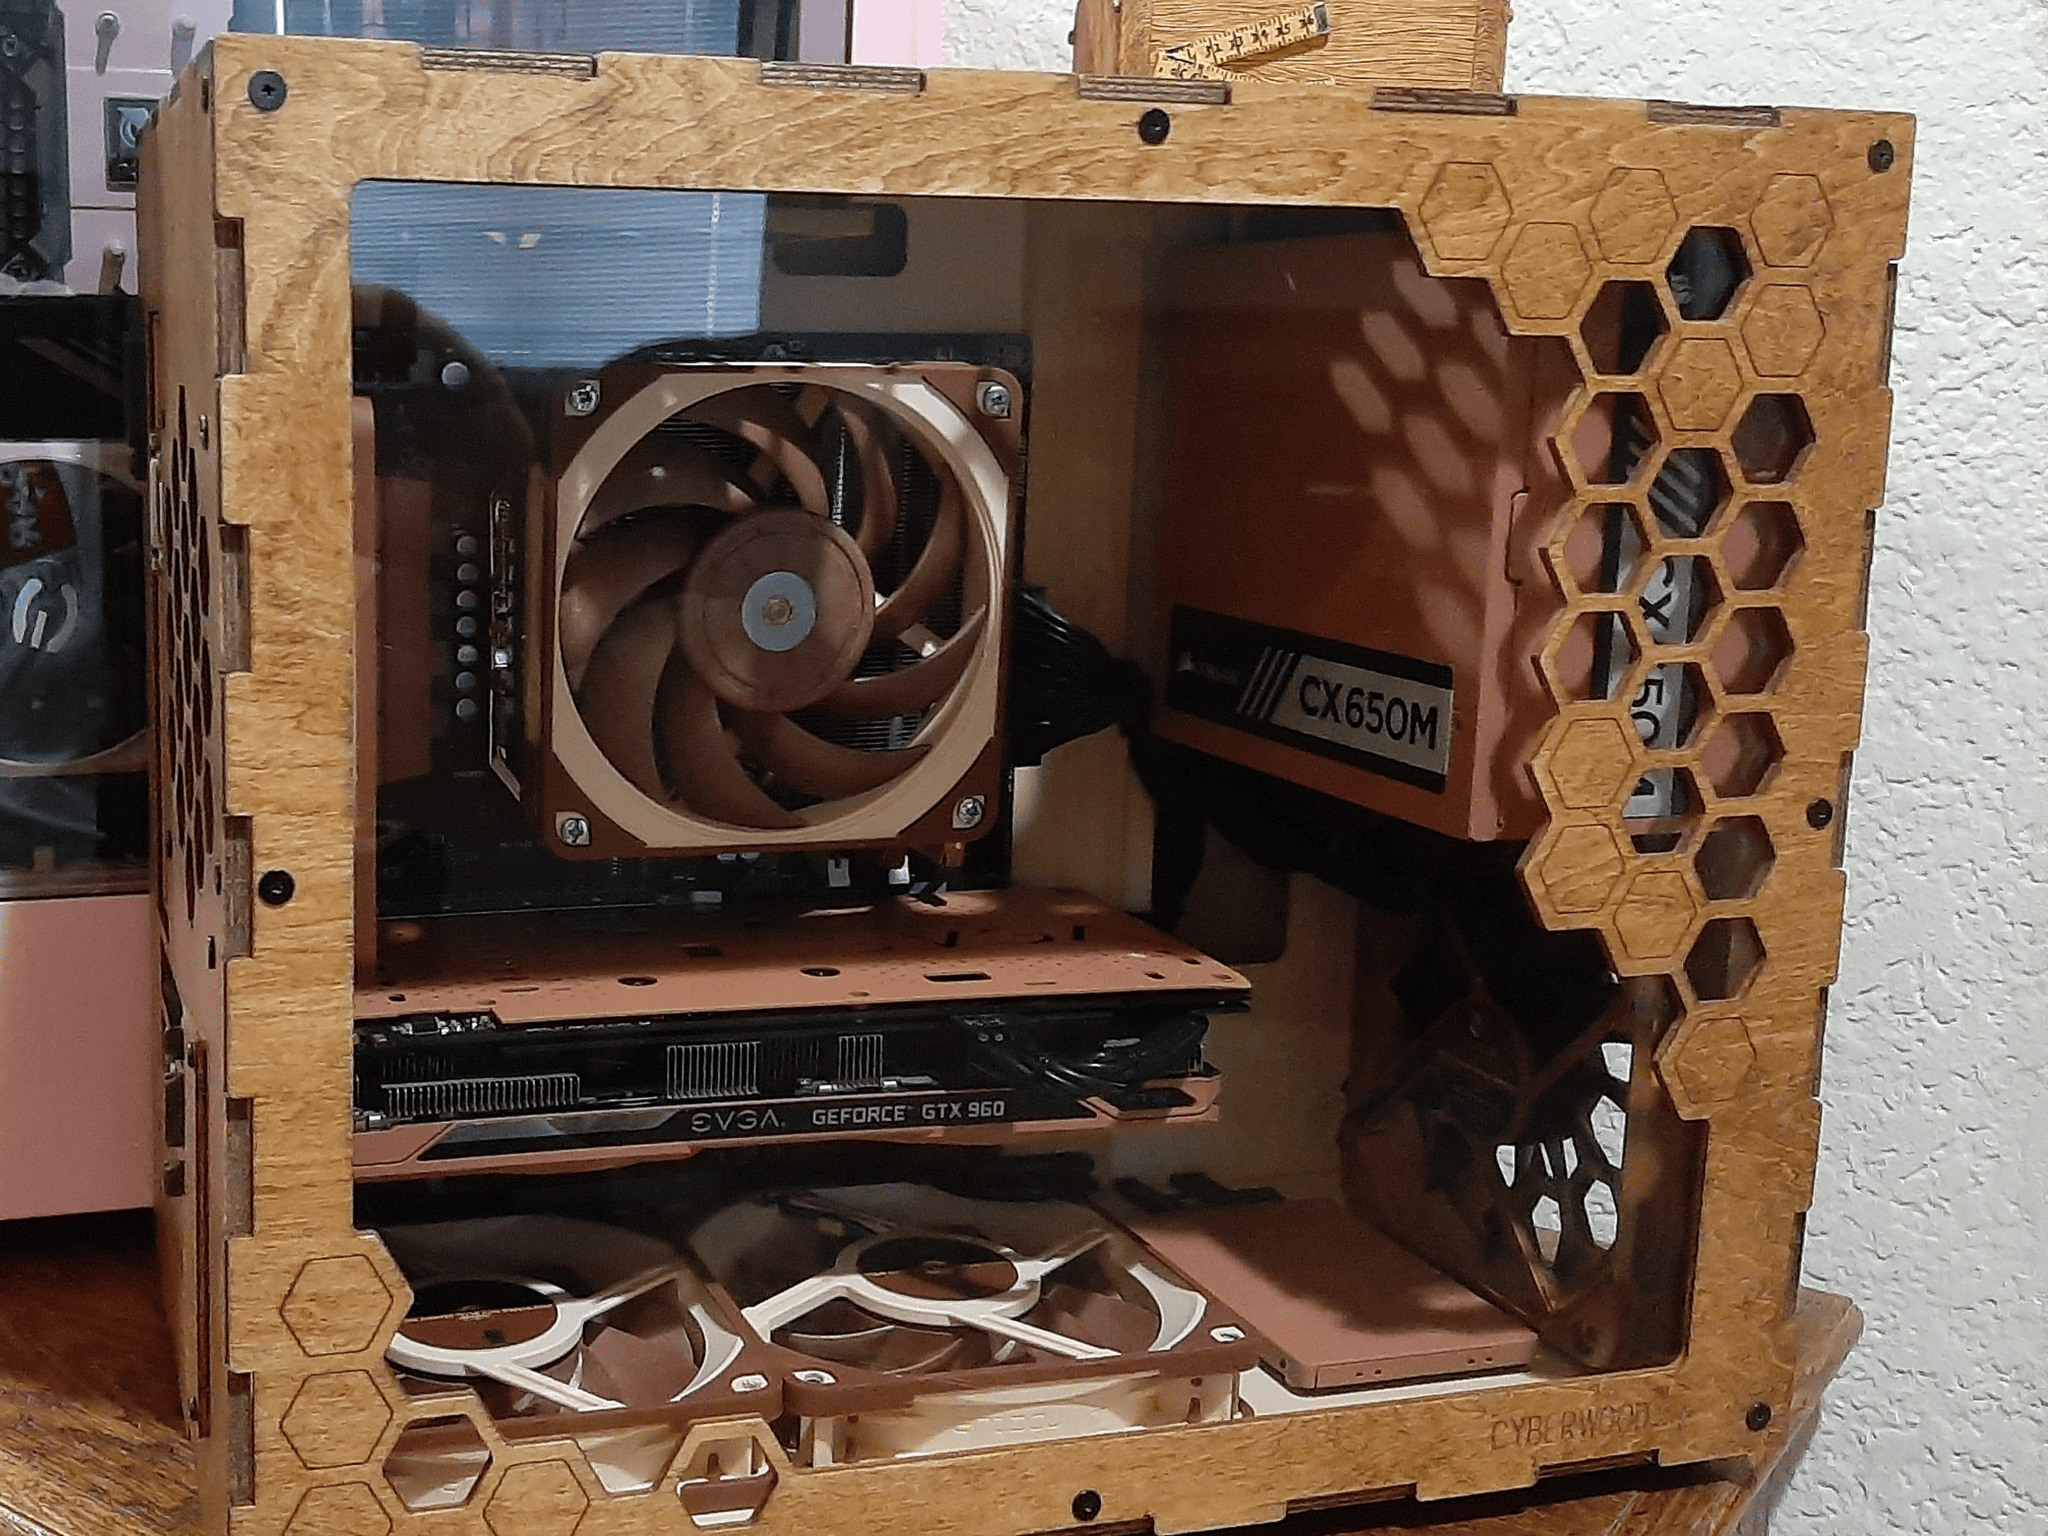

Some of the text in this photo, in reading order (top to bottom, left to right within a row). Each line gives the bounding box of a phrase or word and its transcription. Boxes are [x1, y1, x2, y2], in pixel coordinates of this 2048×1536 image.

[1299, 675, 1437, 750] CX650M
[691, 1100, 1005, 1133] EVGA GEFORCE GTX 960
[1491, 1402, 1651, 1450] CYBERWOOD
